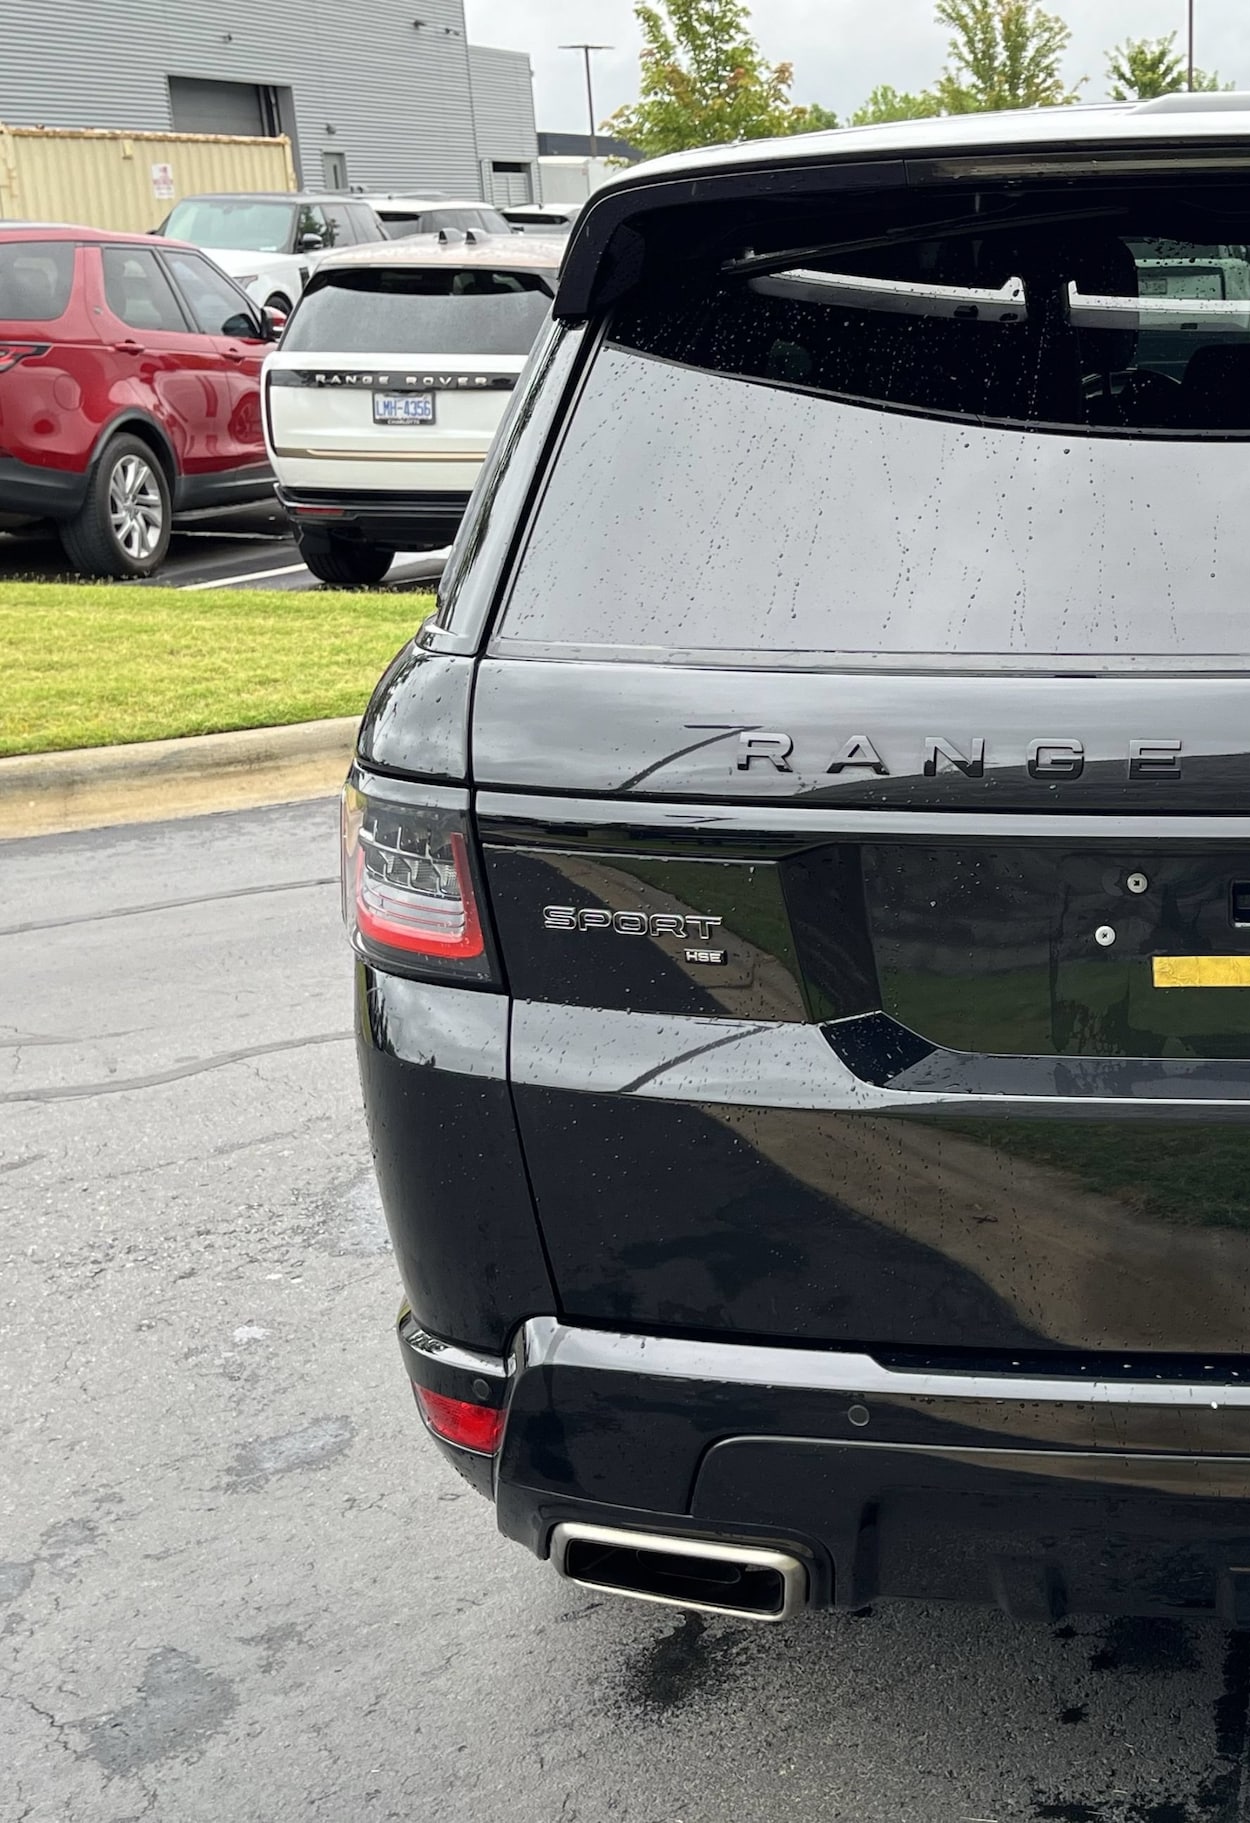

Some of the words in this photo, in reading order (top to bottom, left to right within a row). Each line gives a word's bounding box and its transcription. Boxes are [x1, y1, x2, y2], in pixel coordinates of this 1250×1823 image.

[315, 374, 389, 385] RANGE
[405, 376, 487, 386] ROVER
[375, 401, 431, 417] LMH-4356
[737, 731, 1182, 780] RANGE
[543, 905, 722, 940] SPORT
[685, 950, 722, 963] HSE
